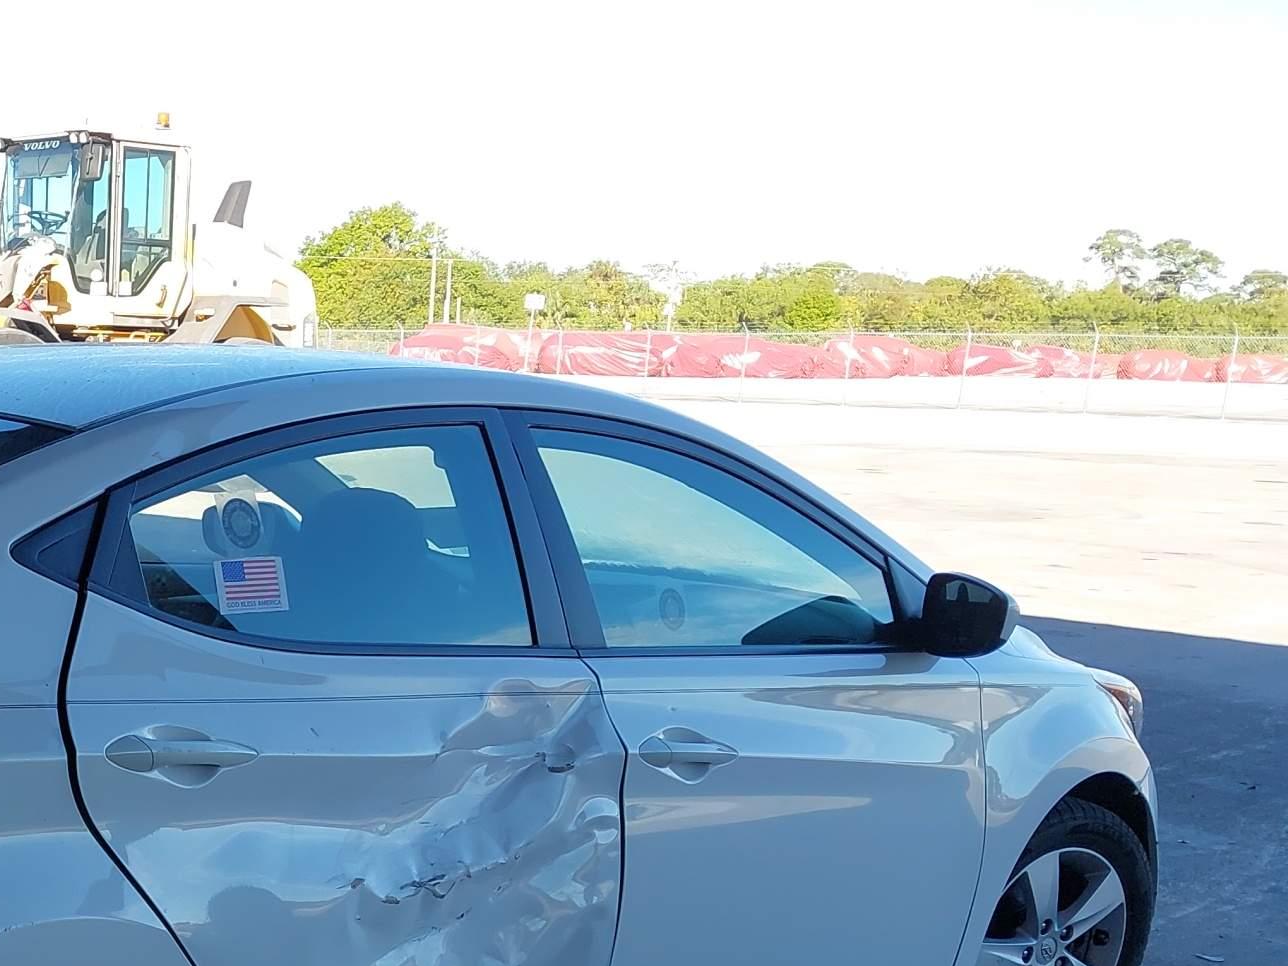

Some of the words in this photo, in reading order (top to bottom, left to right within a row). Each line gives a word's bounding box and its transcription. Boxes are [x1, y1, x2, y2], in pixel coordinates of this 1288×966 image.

[23, 140, 60, 152] VOLVO
[226, 601, 240, 609] GOD
[241, 600, 257, 608] BLESS
[258, 599, 281, 608] AMERICA
